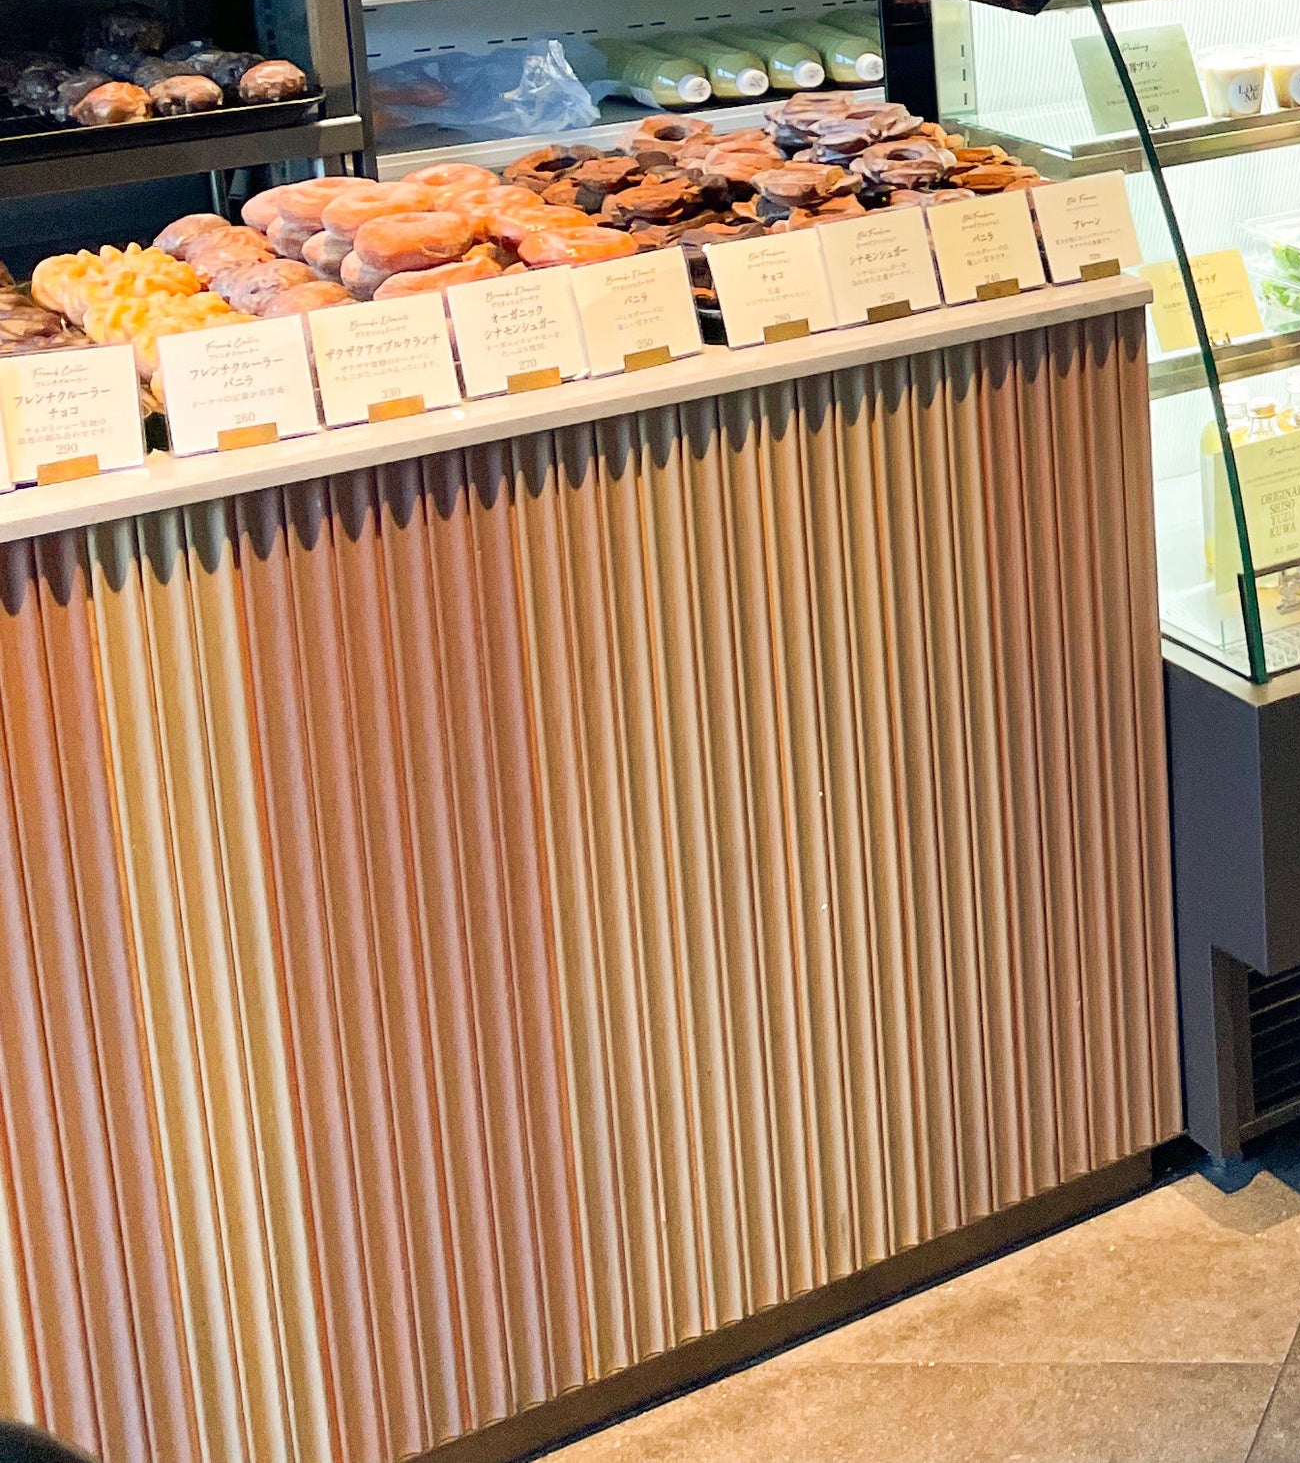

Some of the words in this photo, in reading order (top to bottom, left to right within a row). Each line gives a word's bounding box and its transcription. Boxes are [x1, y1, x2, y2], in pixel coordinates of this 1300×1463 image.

[491, 305, 543, 324] オーガニック
[484, 318, 556, 341] シナモンシュガー
[189, 356, 283, 381] フレンチクルーラー
[518, 359, 537, 370] 270
[223, 376, 254, 388] バニラ
[14, 386, 111, 409] フレンチクルーラー
[49, 406, 79, 418] チョコ
[234, 411, 256, 425] 260
[56, 442, 79, 455] 290
[1270, 511, 1295, 526] YUZU
[1269, 522, 1297, 538] KUWA
